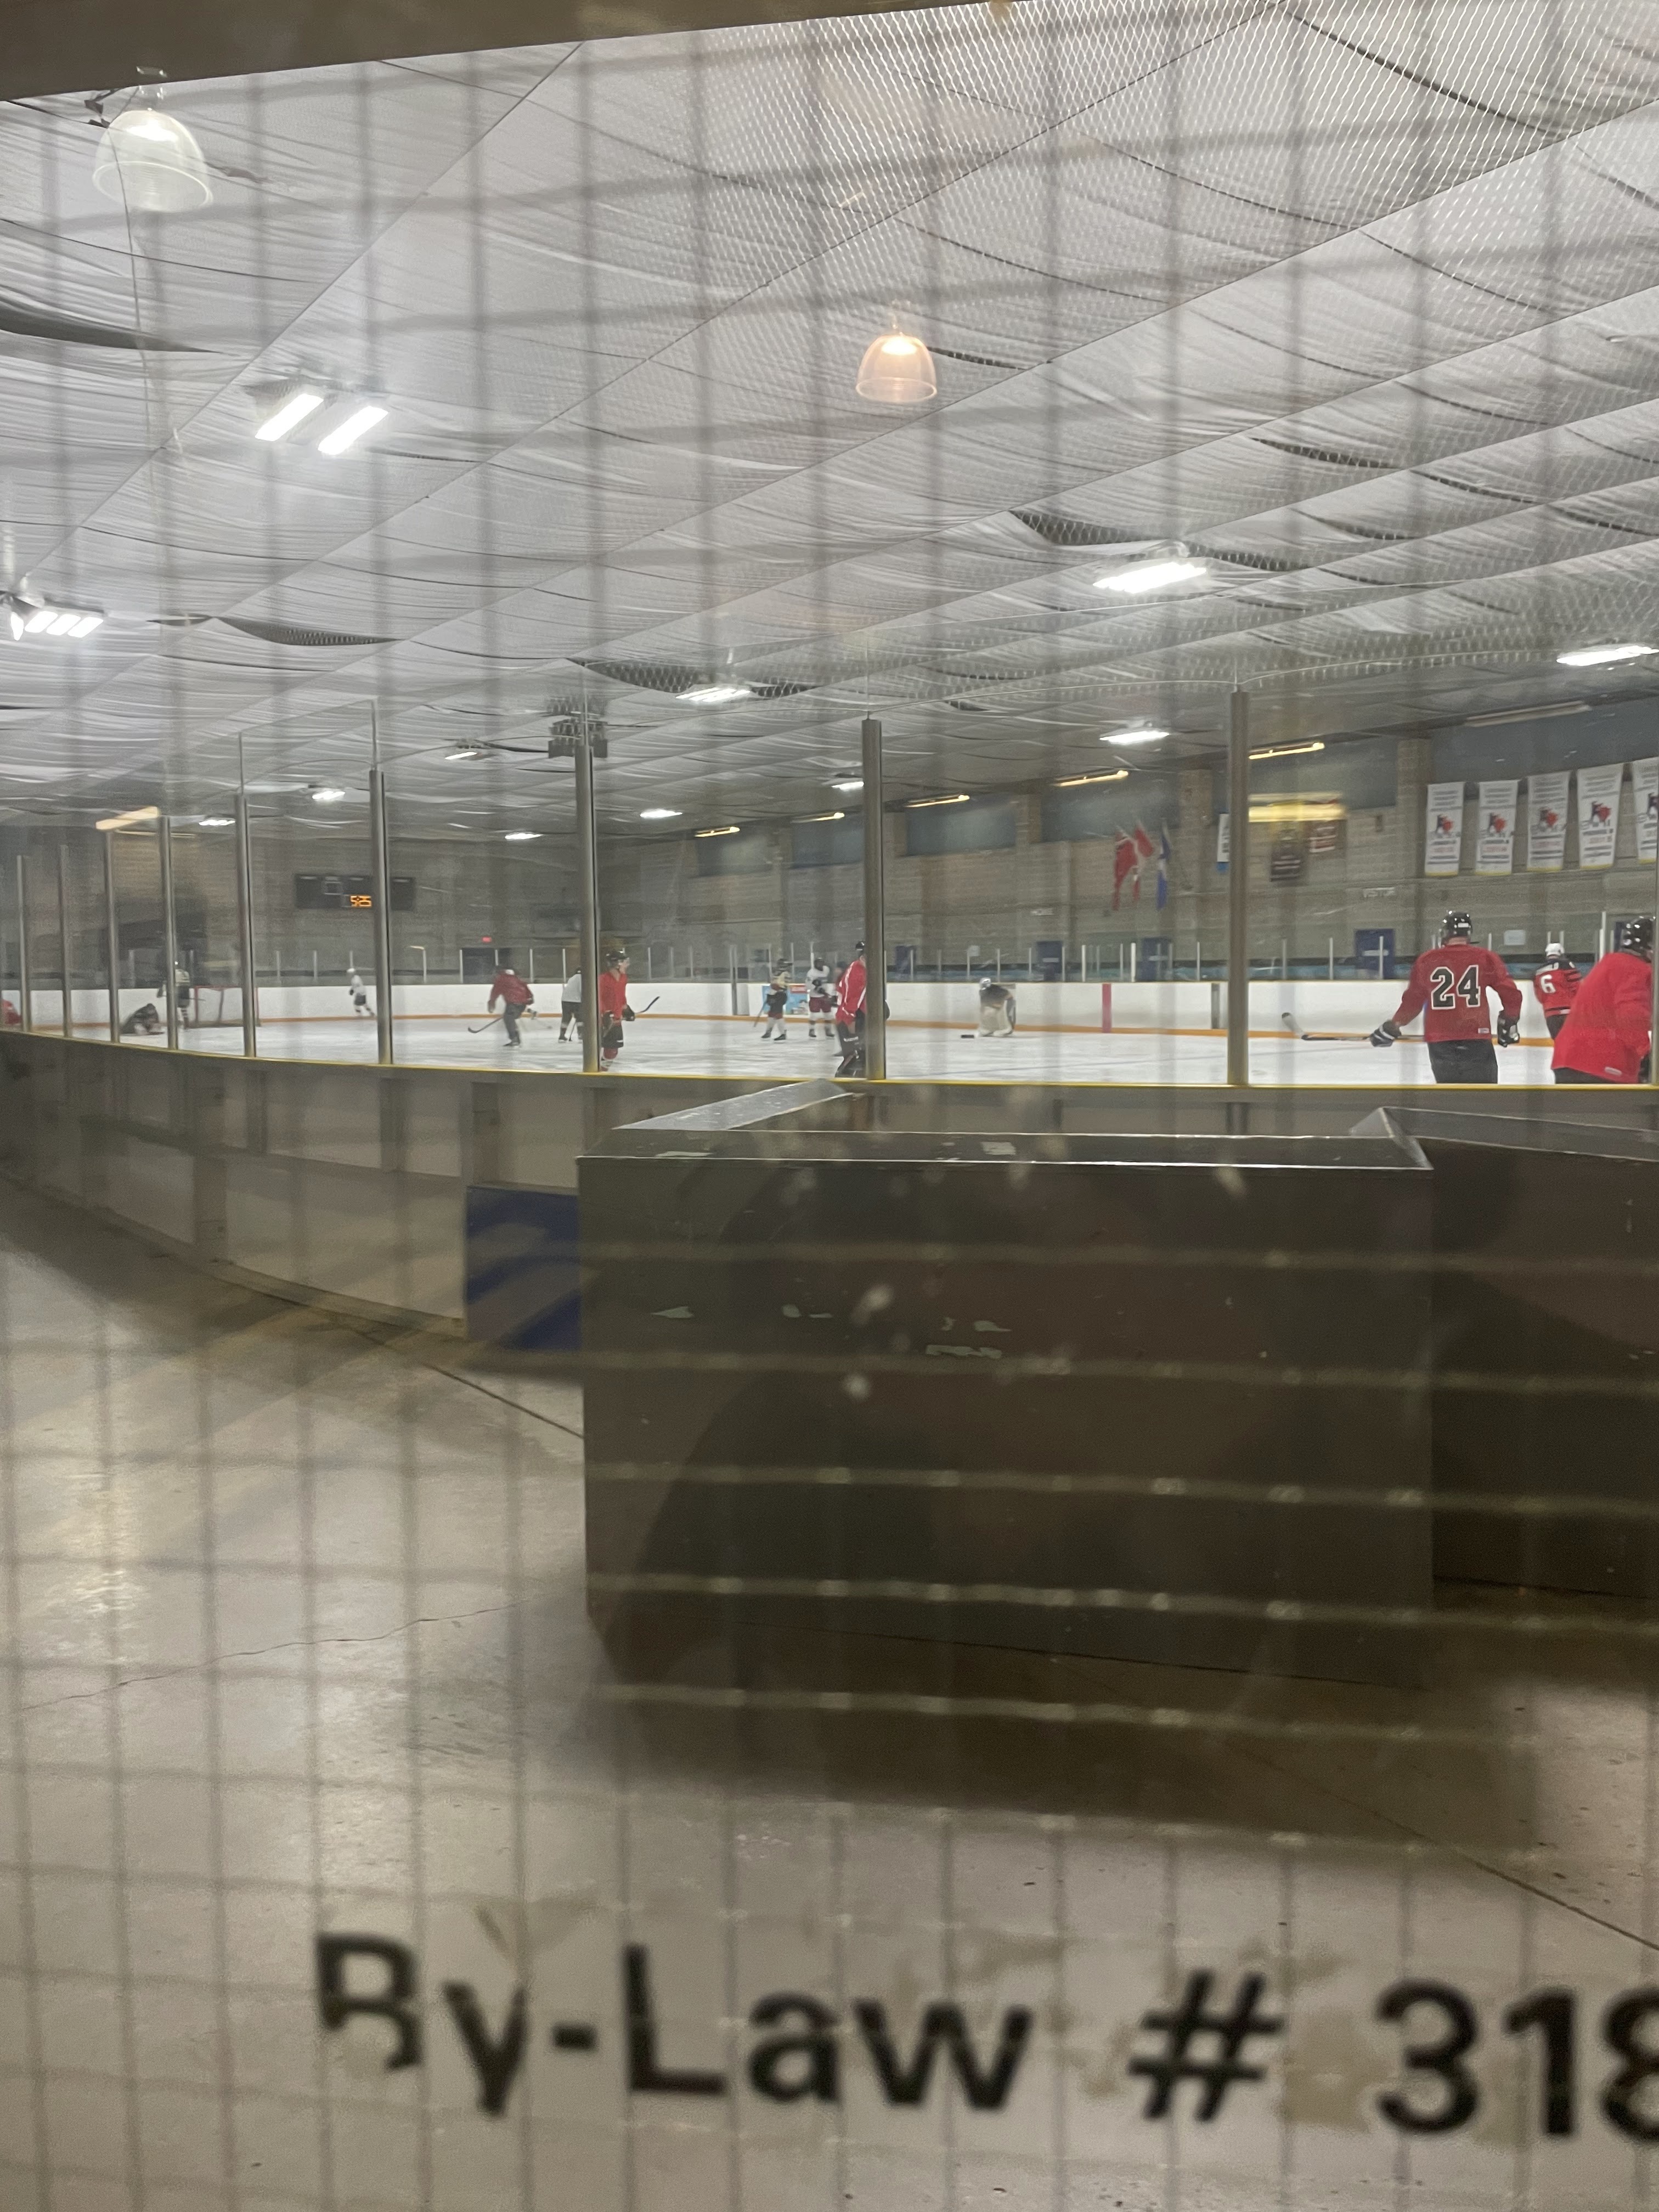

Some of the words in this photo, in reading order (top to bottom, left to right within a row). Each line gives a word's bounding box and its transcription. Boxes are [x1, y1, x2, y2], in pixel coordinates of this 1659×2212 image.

[1430, 964, 1481, 1010] 24
[1541, 974, 1556, 994] 6
[316, 1933, 1032, 2115] By-Law
[1126, 1968, 1285, 2122] #
